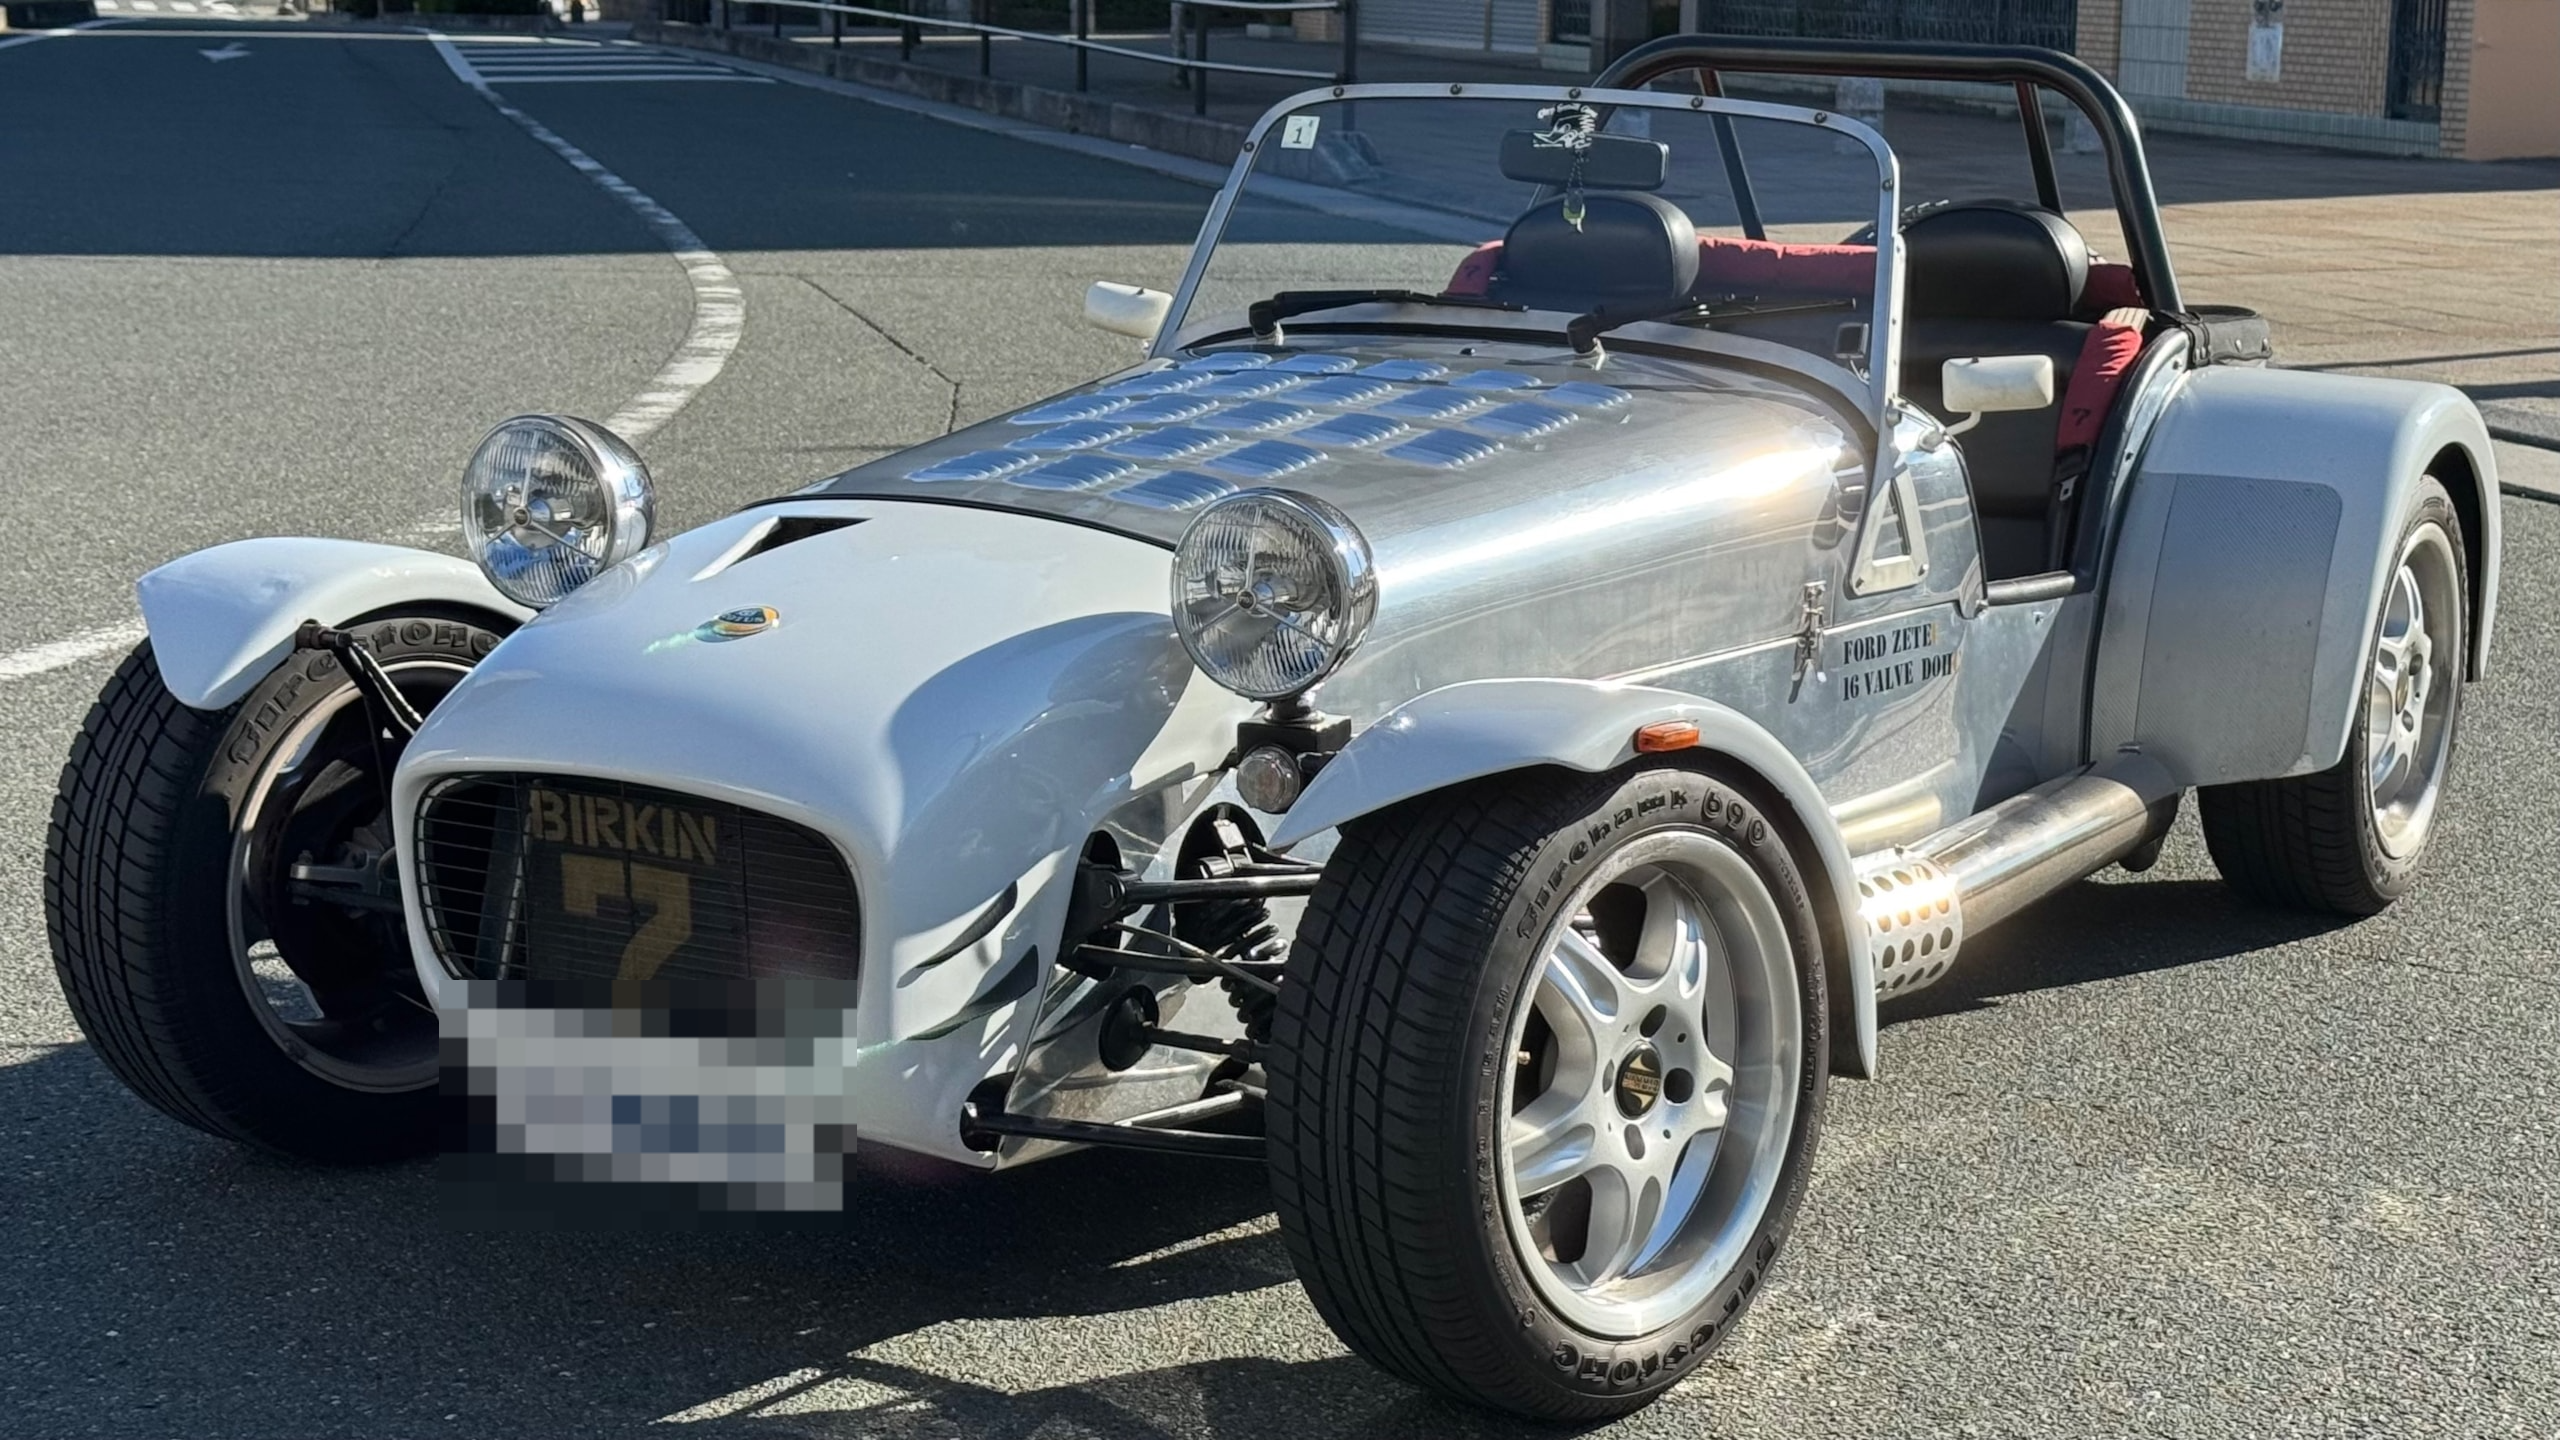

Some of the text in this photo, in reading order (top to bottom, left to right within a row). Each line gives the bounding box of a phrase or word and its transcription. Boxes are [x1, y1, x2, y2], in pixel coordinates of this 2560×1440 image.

[1292, 127, 1303, 144] 1
[1843, 634, 1887, 665] FORD
[1843, 676, 1860, 701] 16
[1864, 660, 1914, 695] VALVE
[529, 788, 718, 866] BIRKIN
[1701, 786, 1768, 849] 690
